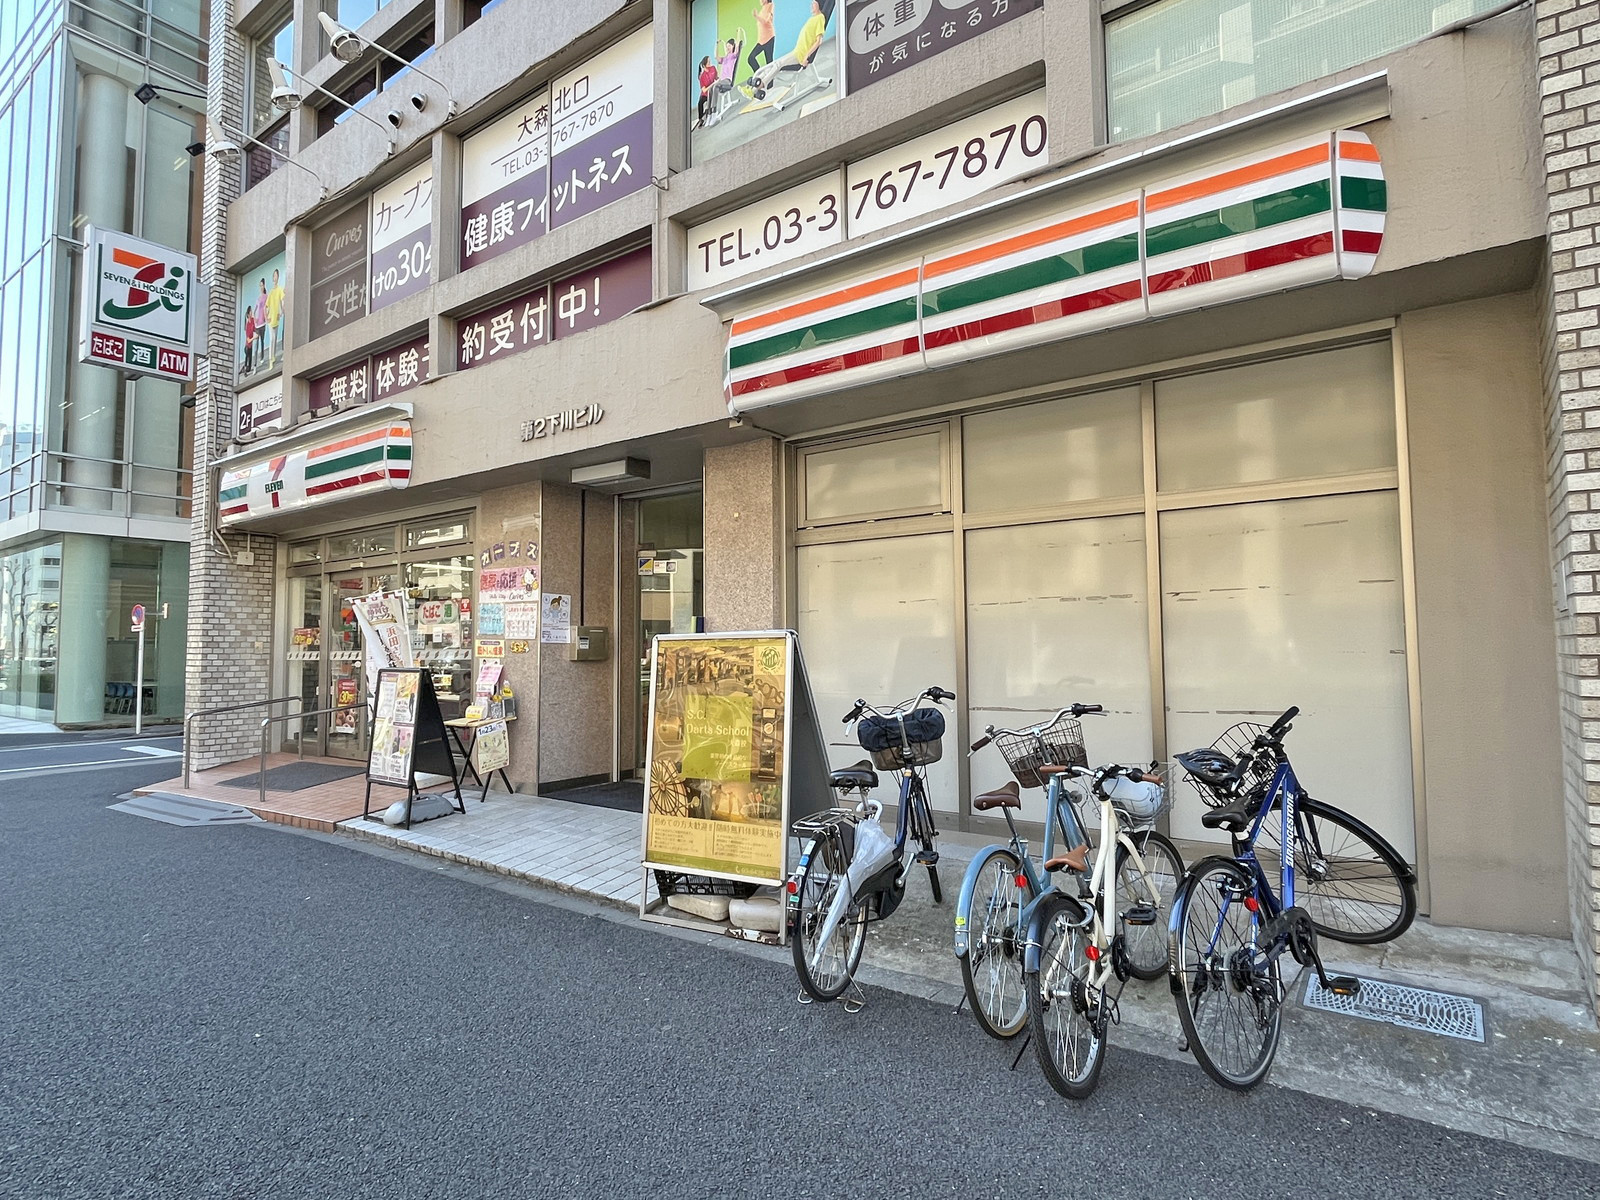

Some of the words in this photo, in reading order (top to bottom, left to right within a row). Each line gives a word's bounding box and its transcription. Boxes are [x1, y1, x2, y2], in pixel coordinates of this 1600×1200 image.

[464, 144, 633, 257] 健康フィットネス
[142, 284, 185, 301] HOLDINGS
[93, 336, 123, 358] たばこ
[132, 344, 152, 364] 酒
[160, 352, 187, 372] ATM
[240, 410, 251, 430] 2F
[520, 402, 604, 442] 第2下川ビル
[265, 479, 284, 494] ELEVEN
[423, 603, 441, 619] たばこ
[686, 723, 713, 735] Darts
[715, 725, 750, 736] School
